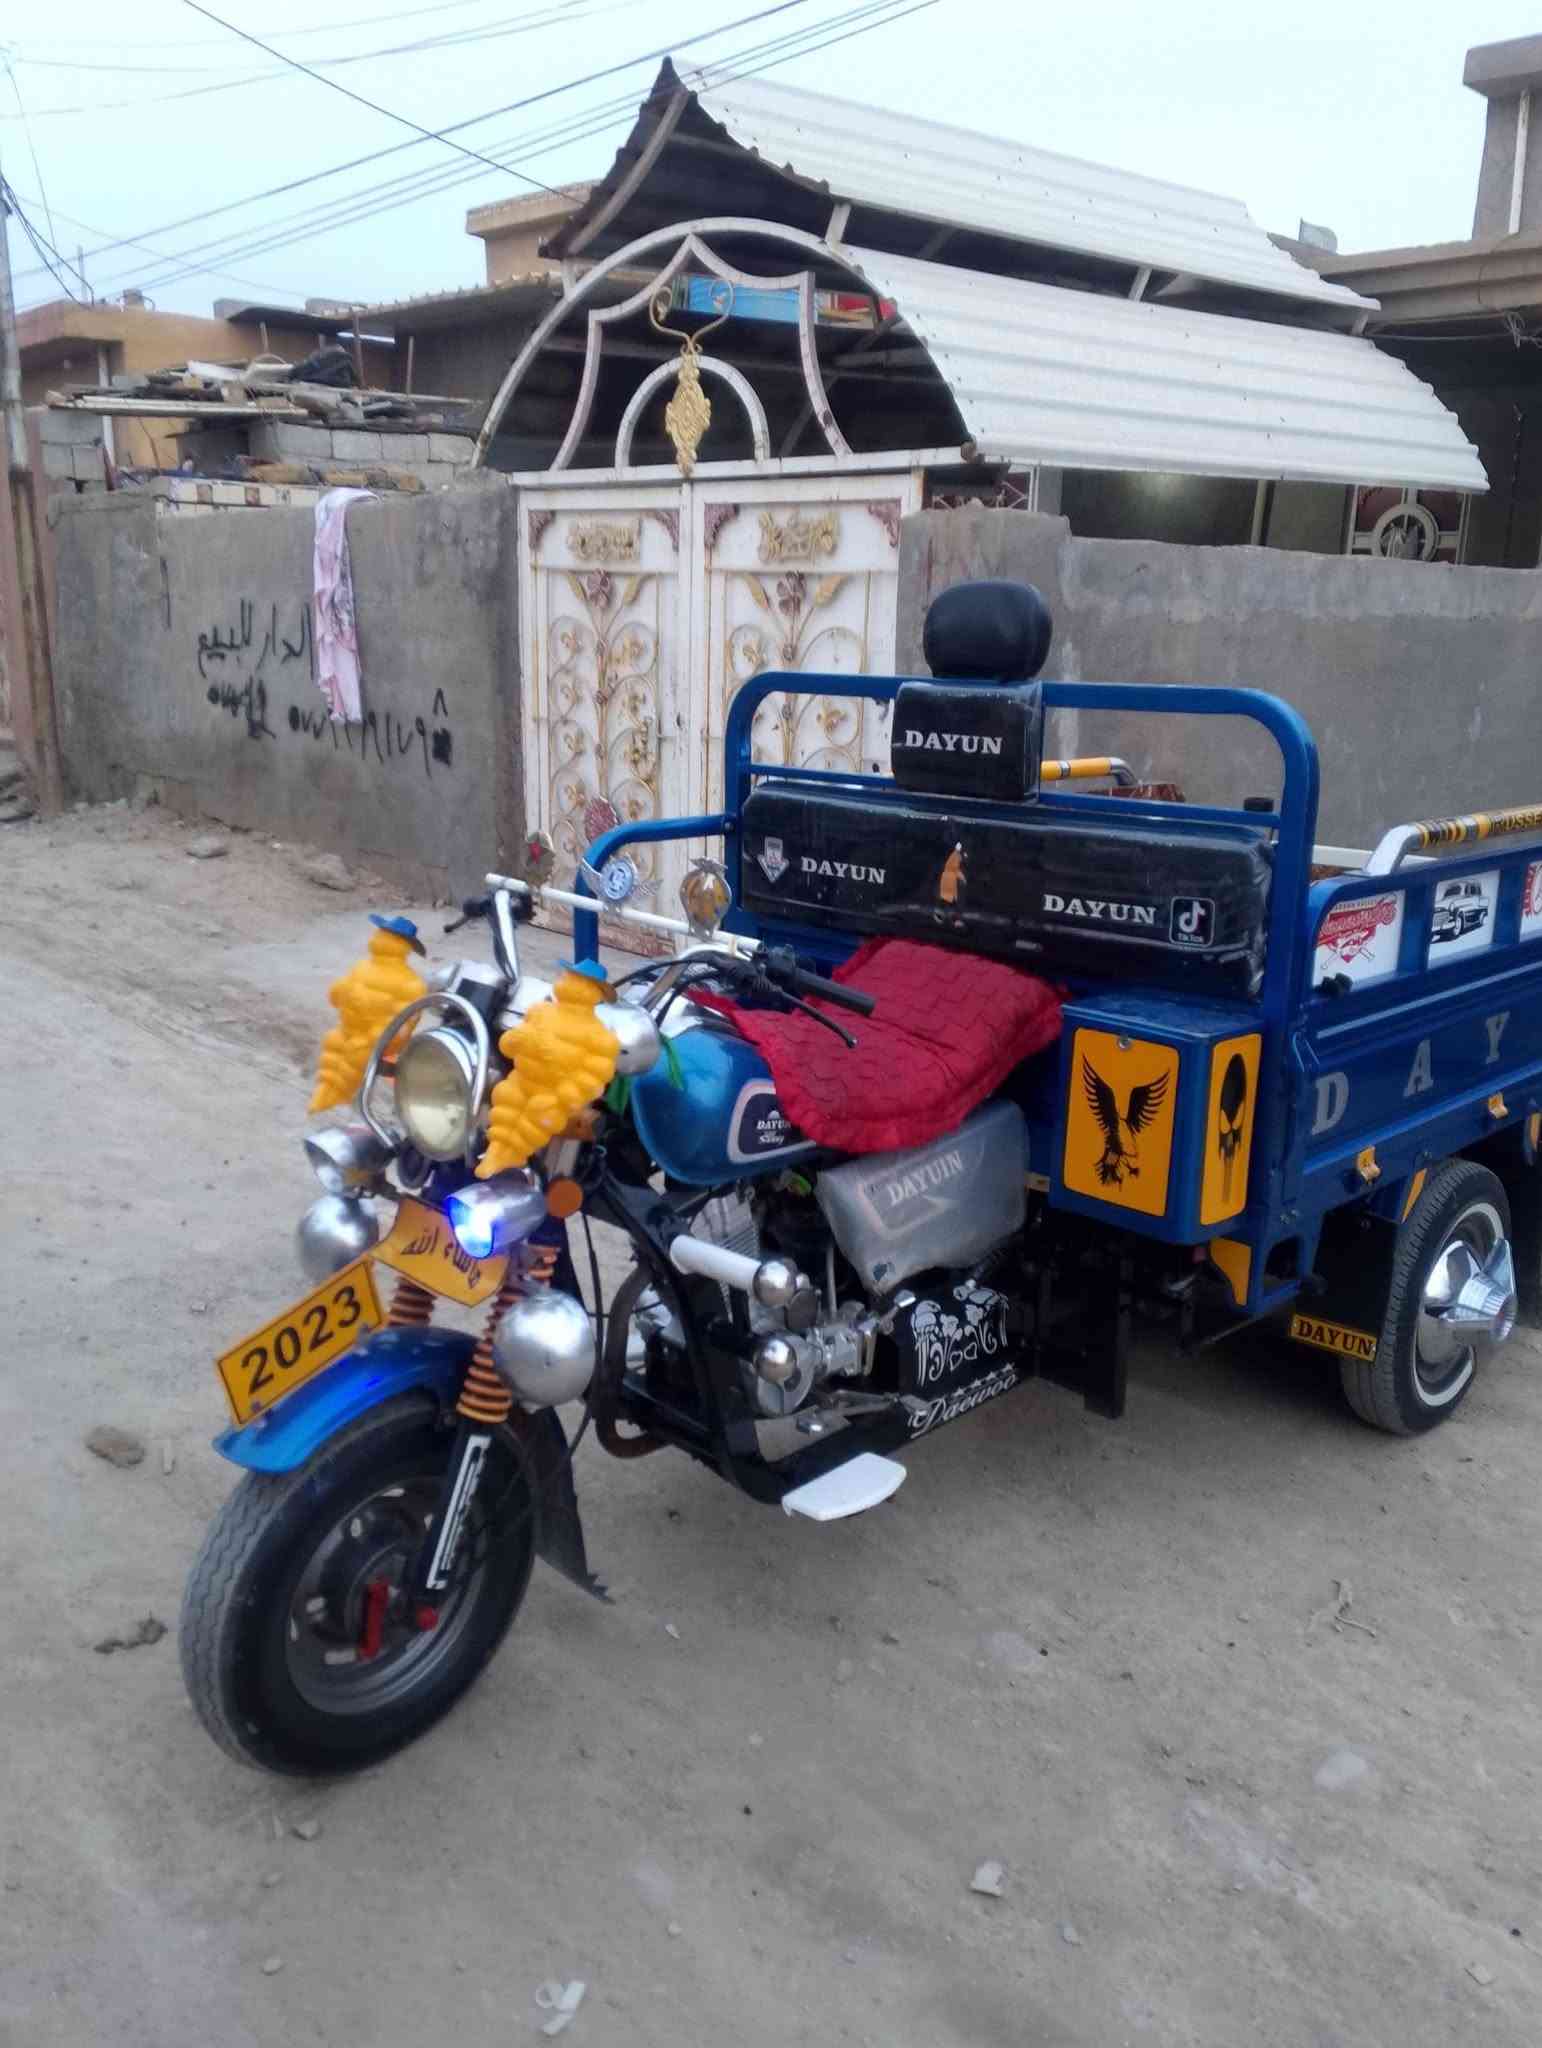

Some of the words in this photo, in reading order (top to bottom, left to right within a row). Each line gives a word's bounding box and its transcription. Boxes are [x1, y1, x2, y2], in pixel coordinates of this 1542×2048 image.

[904, 730, 1002, 754] DAYUN
[801, 856, 887, 884] DAYUN
[1043, 894, 1157, 924] DAYUN
[241, 1285, 361, 1397] 2023
[1299, 1320, 1374, 1357] DAYUN
